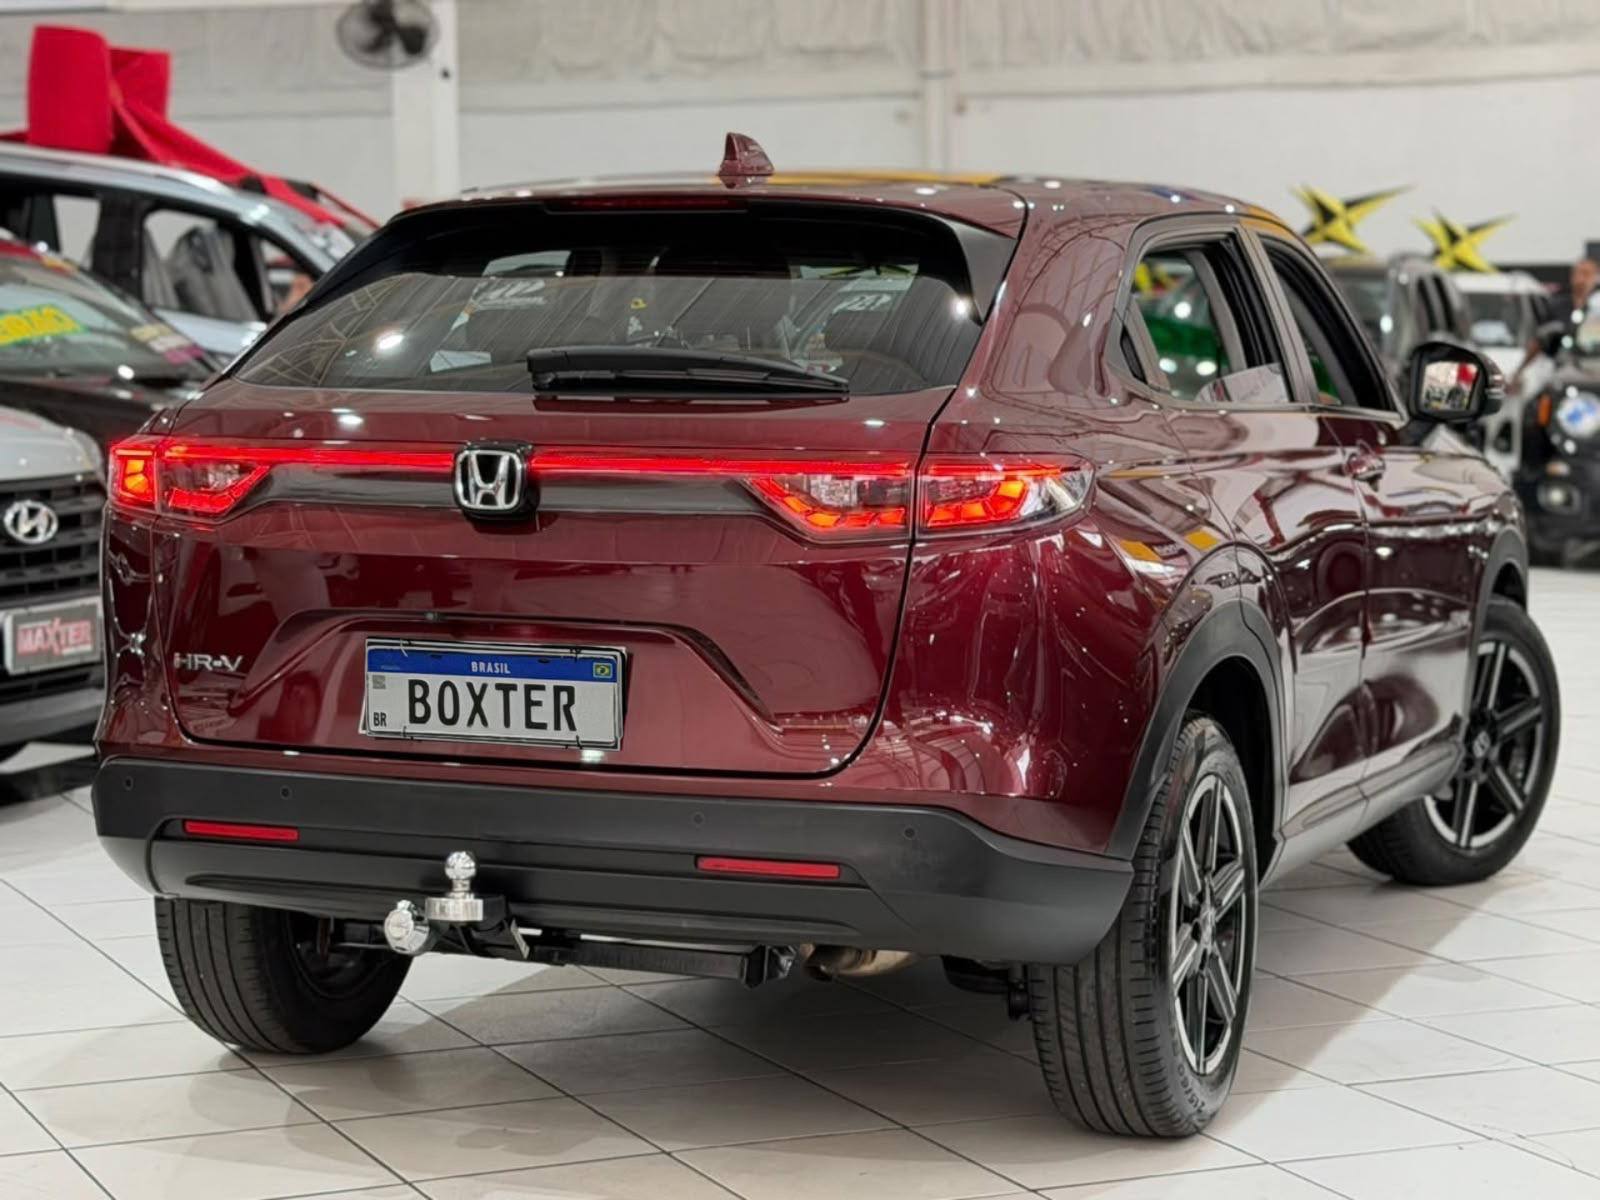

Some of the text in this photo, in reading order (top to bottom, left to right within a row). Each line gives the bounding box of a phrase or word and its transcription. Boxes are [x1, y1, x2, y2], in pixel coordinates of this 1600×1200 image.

[173, 652, 243, 671] HR-V
[471, 661, 511, 674] BRASIL
[407, 679, 577, 731] BOXTER
[373, 712, 387, 727] BR
